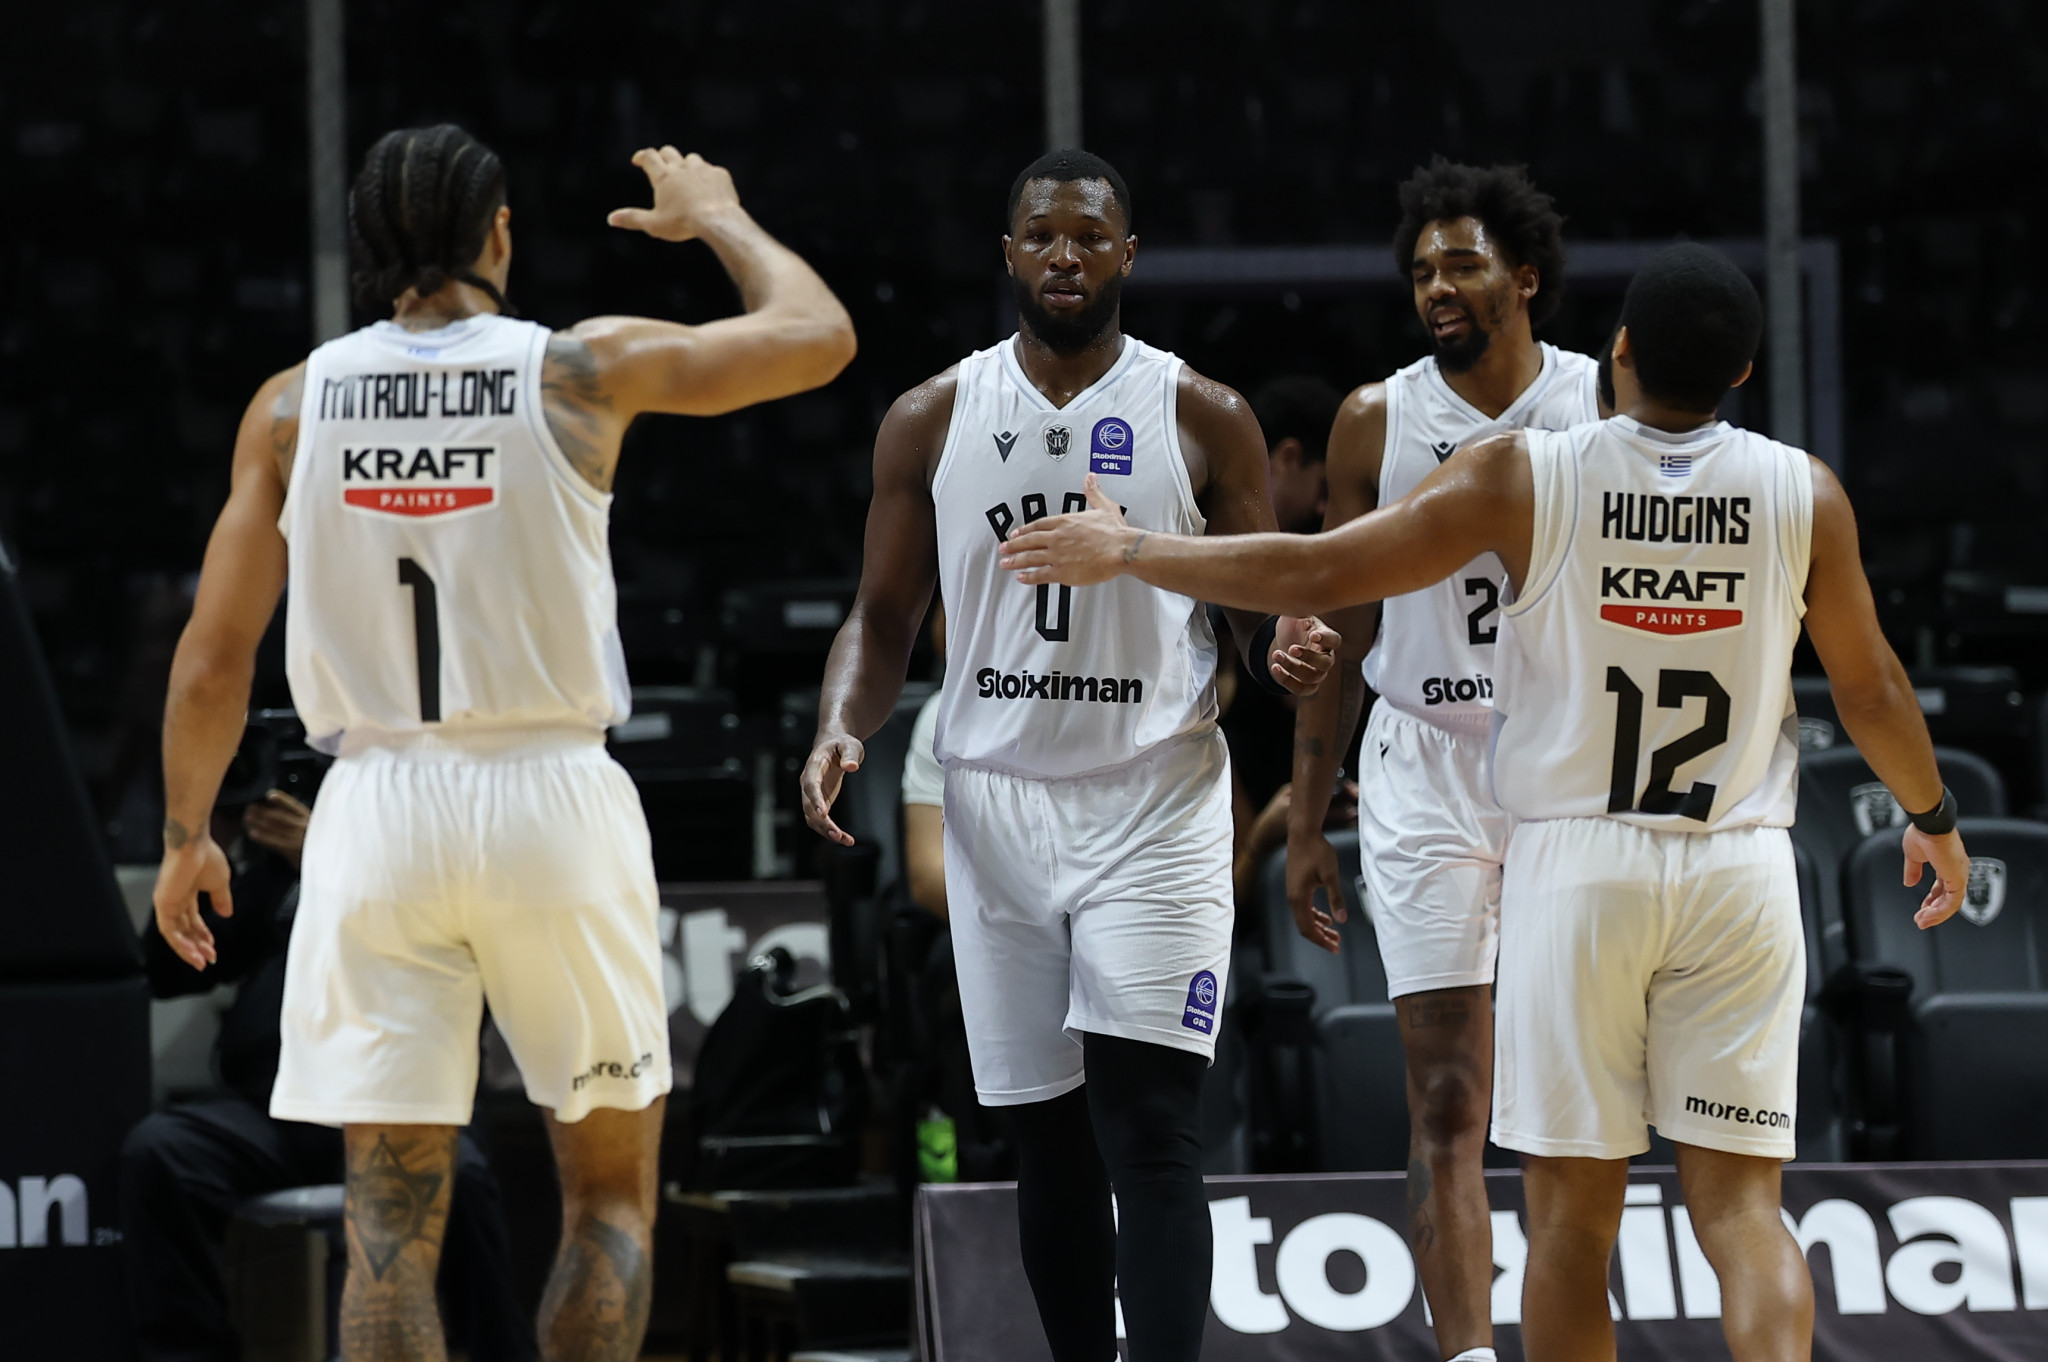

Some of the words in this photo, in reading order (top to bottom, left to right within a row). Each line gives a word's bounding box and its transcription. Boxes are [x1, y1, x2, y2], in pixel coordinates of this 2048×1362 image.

[320, 369, 516, 420] MITROU-LONG
[343, 447, 494, 480] KRAFT
[1101, 462, 1121, 470] GBL
[379, 491, 456, 508] PAINTS
[985, 492, 1128, 543] PA
[1602, 491, 1750, 545] HUDGINS
[1601, 566, 1745, 603] KRAFT
[1636, 612, 1708, 626] PAINTS
[398, 558, 440, 722] 1
[976, 667, 1143, 704] Stoiximan
[1606, 665, 1731, 823] 12
[1192, 1017, 1207, 1029] GBL
[1685, 1096, 1790, 1129] more.com
